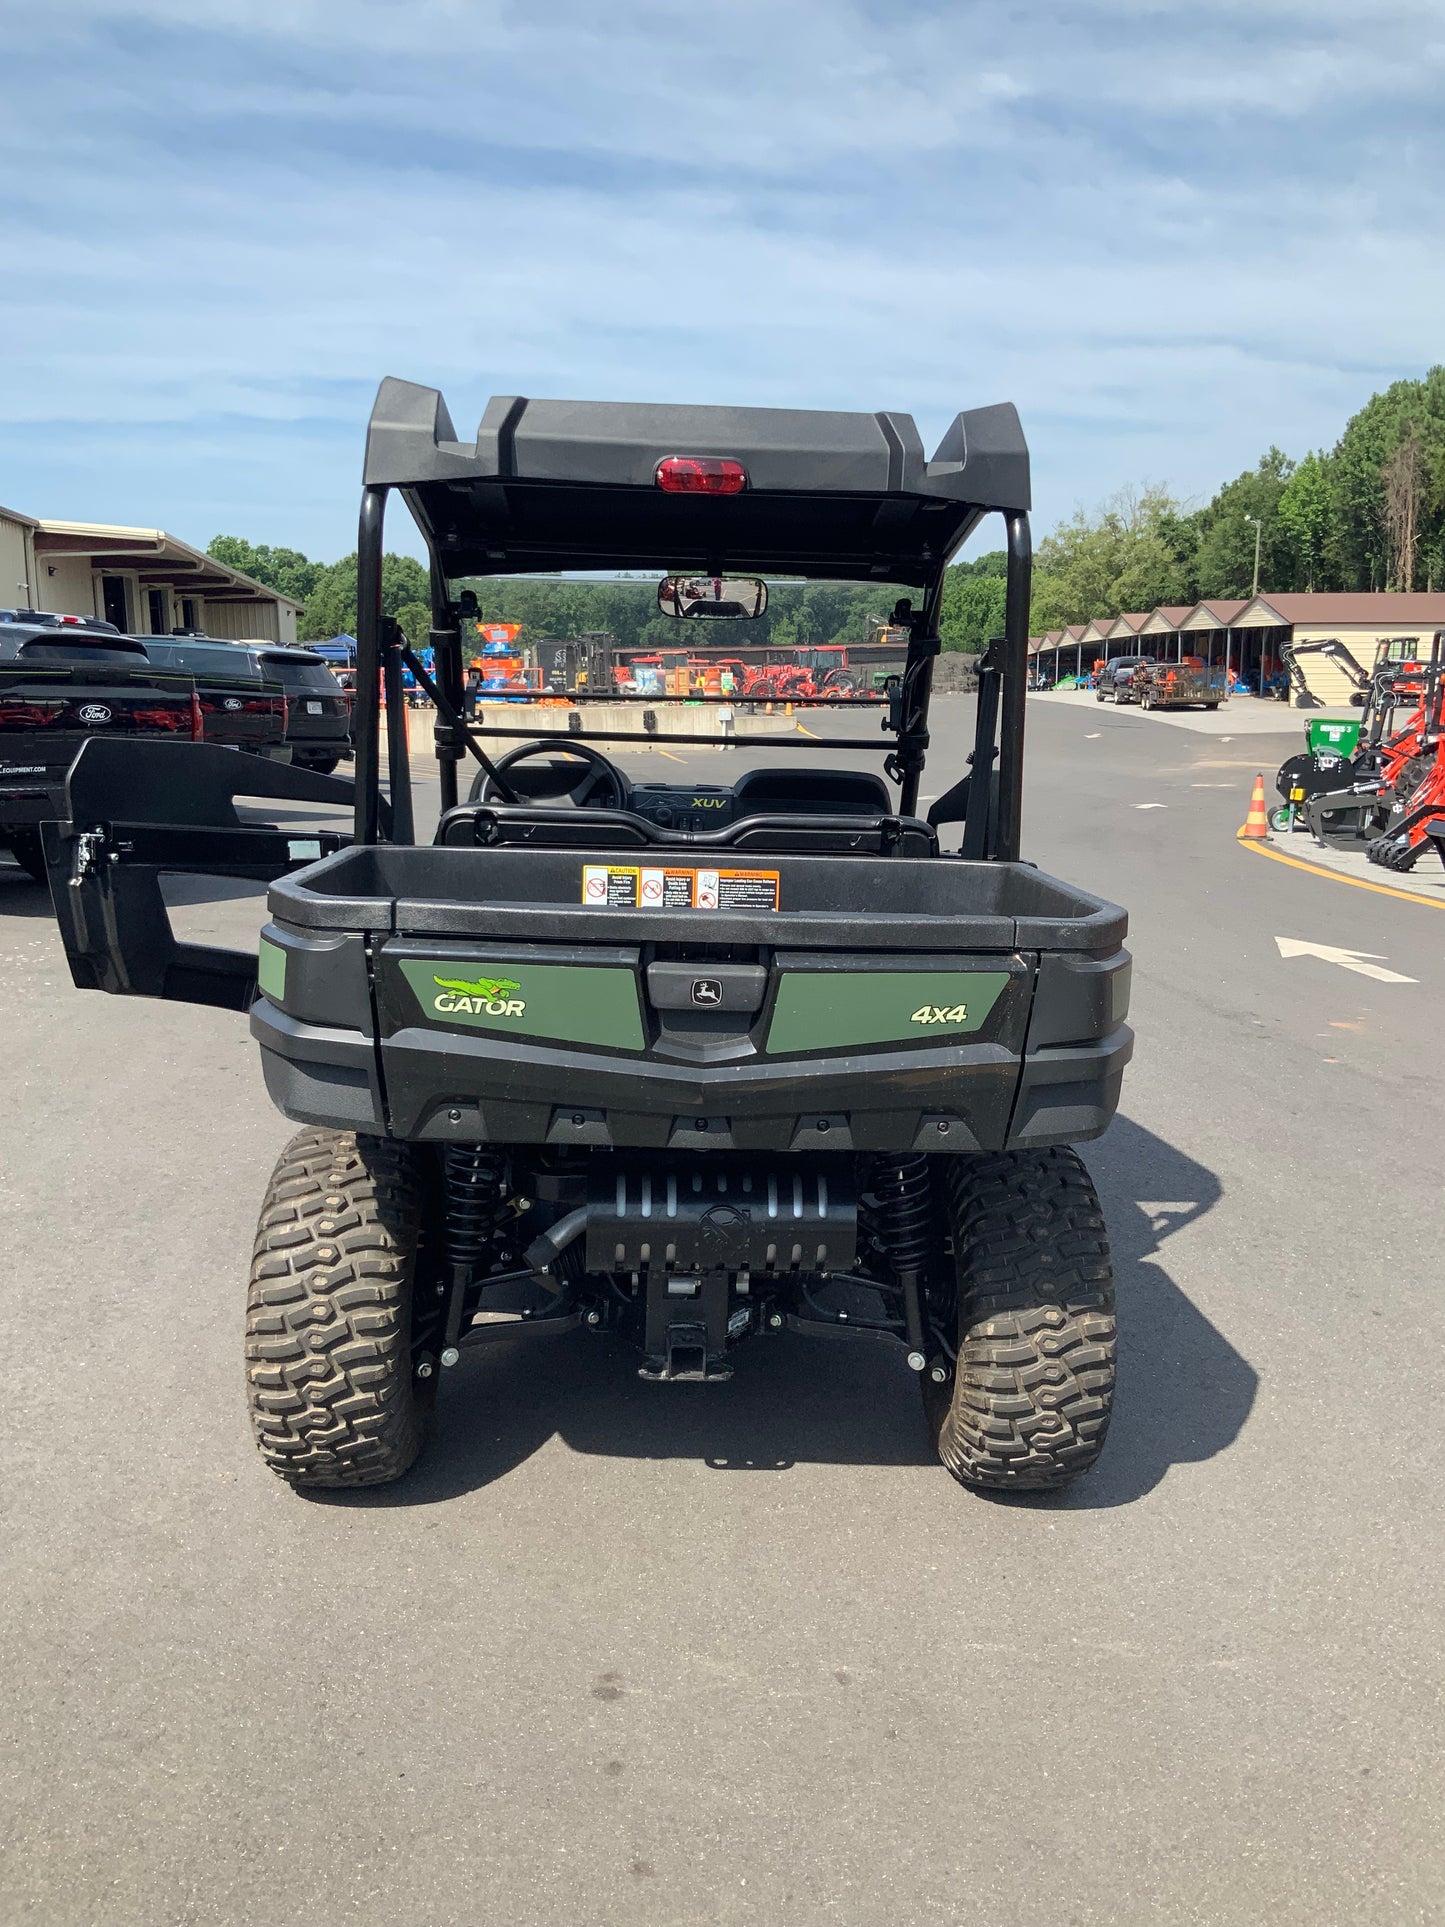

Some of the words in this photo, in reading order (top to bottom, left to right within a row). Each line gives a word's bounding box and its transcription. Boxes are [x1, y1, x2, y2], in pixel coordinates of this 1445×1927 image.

[84, 706, 107, 719] Ford
[691, 798, 727, 808] XUV
[434, 993, 526, 1018] GATOR
[910, 1004, 968, 1024] 4x4
